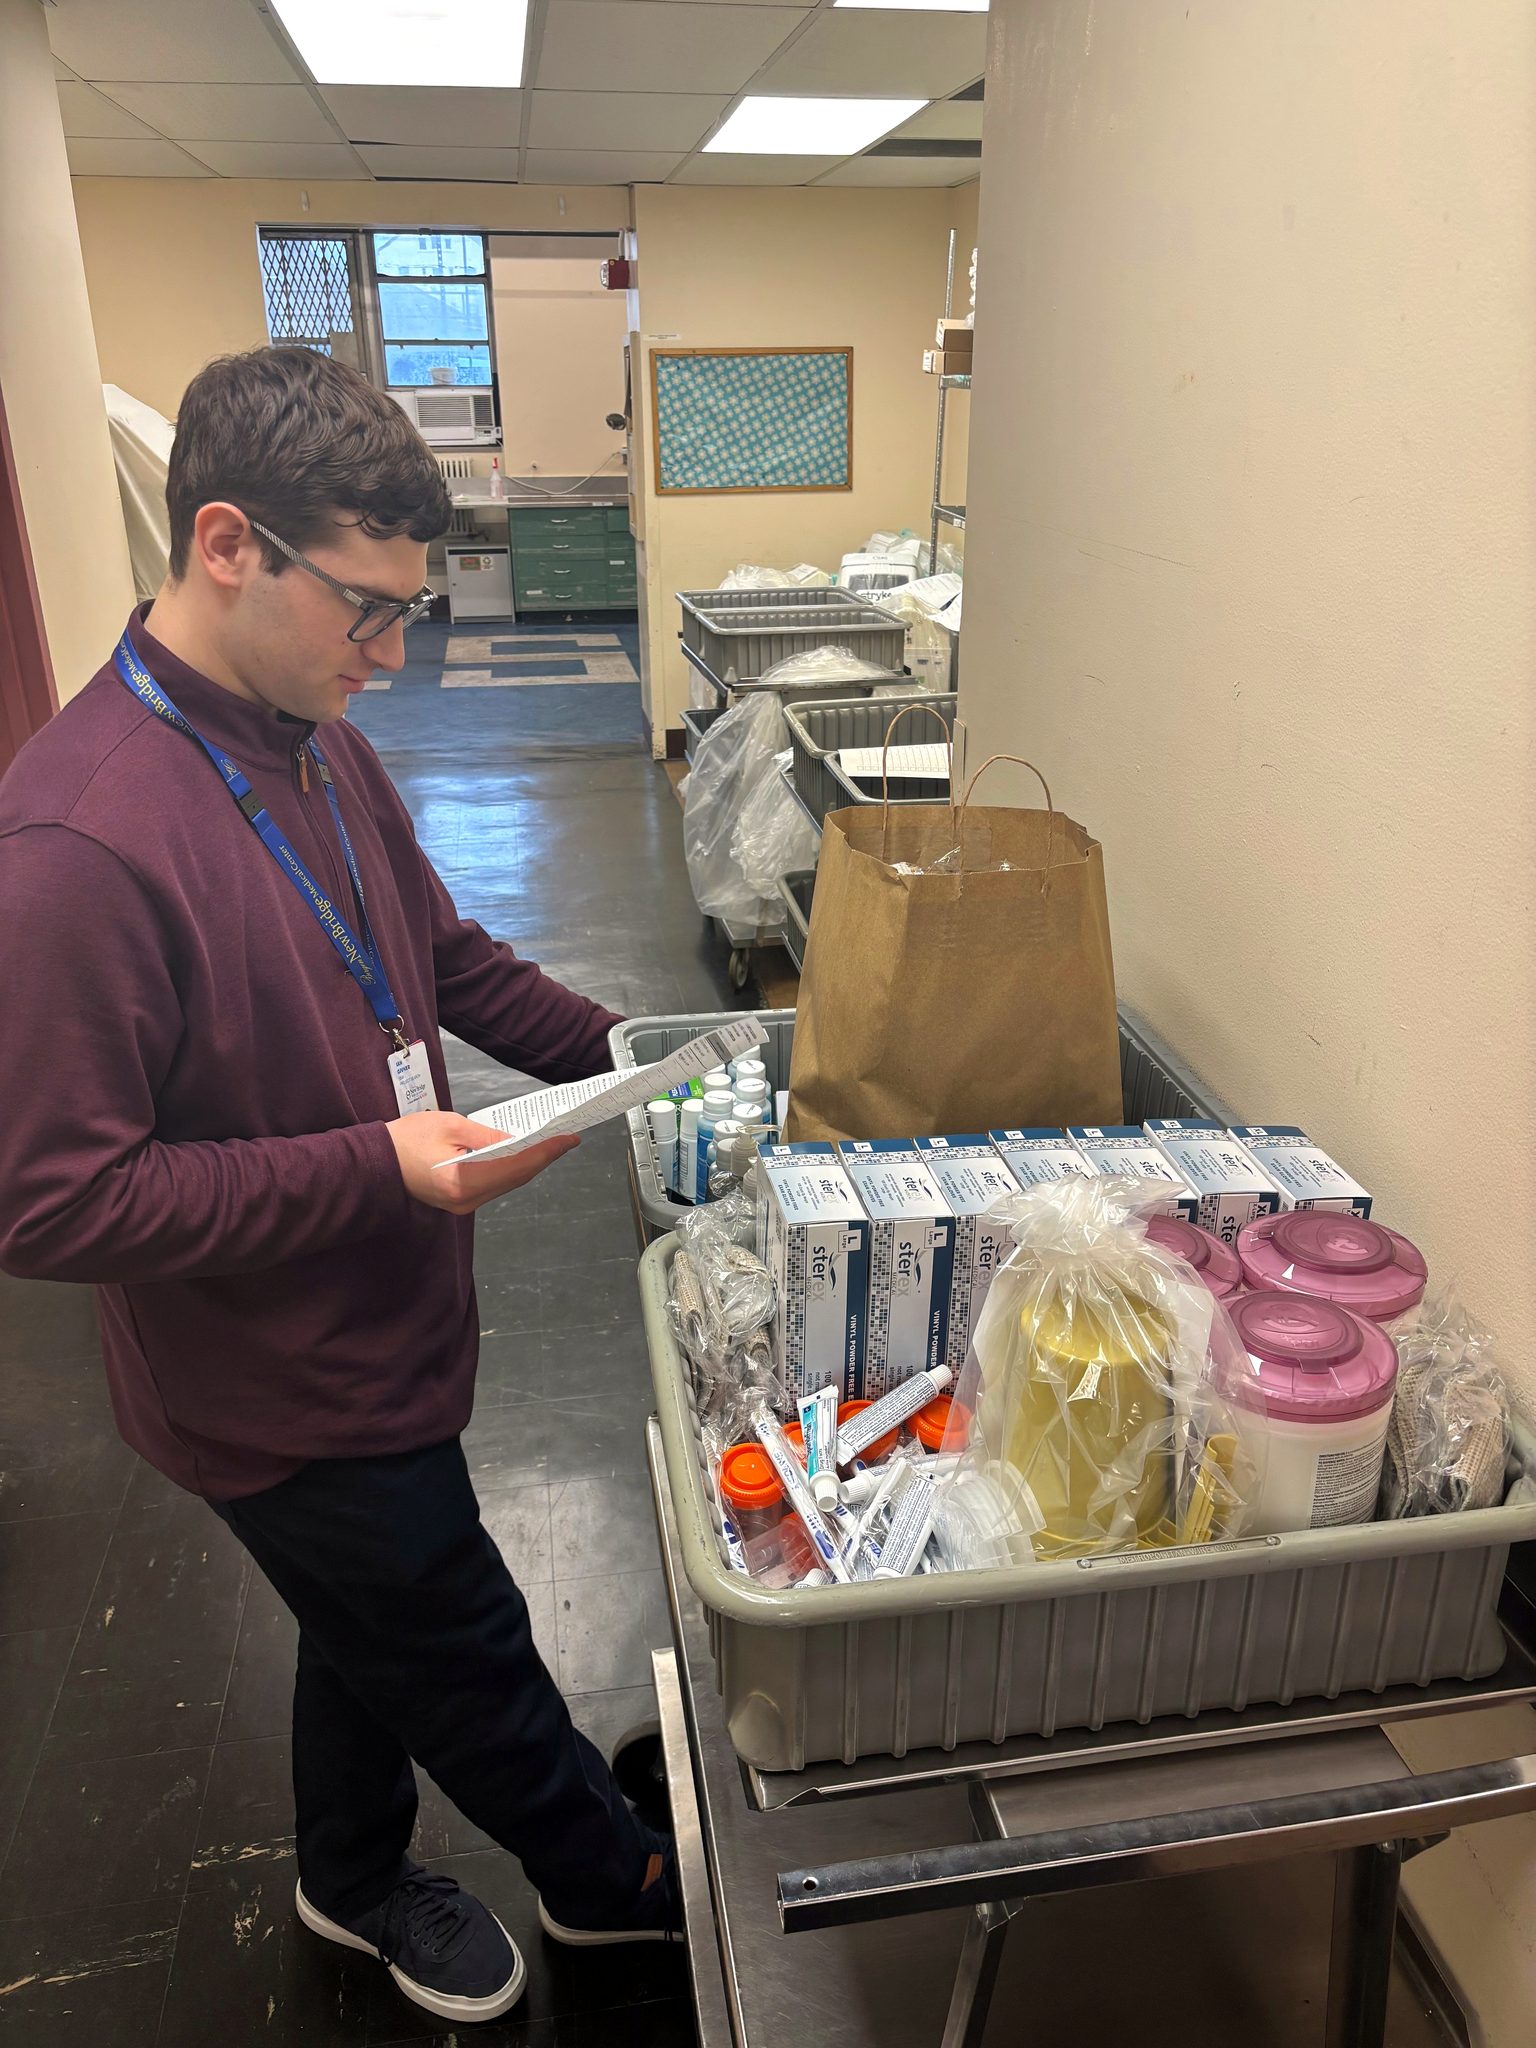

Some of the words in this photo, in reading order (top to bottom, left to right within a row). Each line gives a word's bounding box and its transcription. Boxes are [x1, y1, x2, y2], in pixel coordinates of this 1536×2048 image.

[860, 592, 893, 601] stryke
[1059, 1163, 1074, 1174] ste
[1140, 1161, 1158, 1176] ster
[848, 1235, 857, 1244] L
[934, 1232, 944, 1241] L
[1221, 1216, 1236, 1244] ste
[812, 1246, 828, 1302] sterex
[897, 1242, 915, 1297] sterex
[978, 1235, 996, 1290] sterex
[849, 1314, 857, 1340] VINYL
[933, 1310, 941, 1336] VINYL
[930, 1336, 938, 1367] POWDER
[1119, 1550, 1191, 1565] METROPOLITAN
[1191, 1545, 1211, 1556] WIRE
